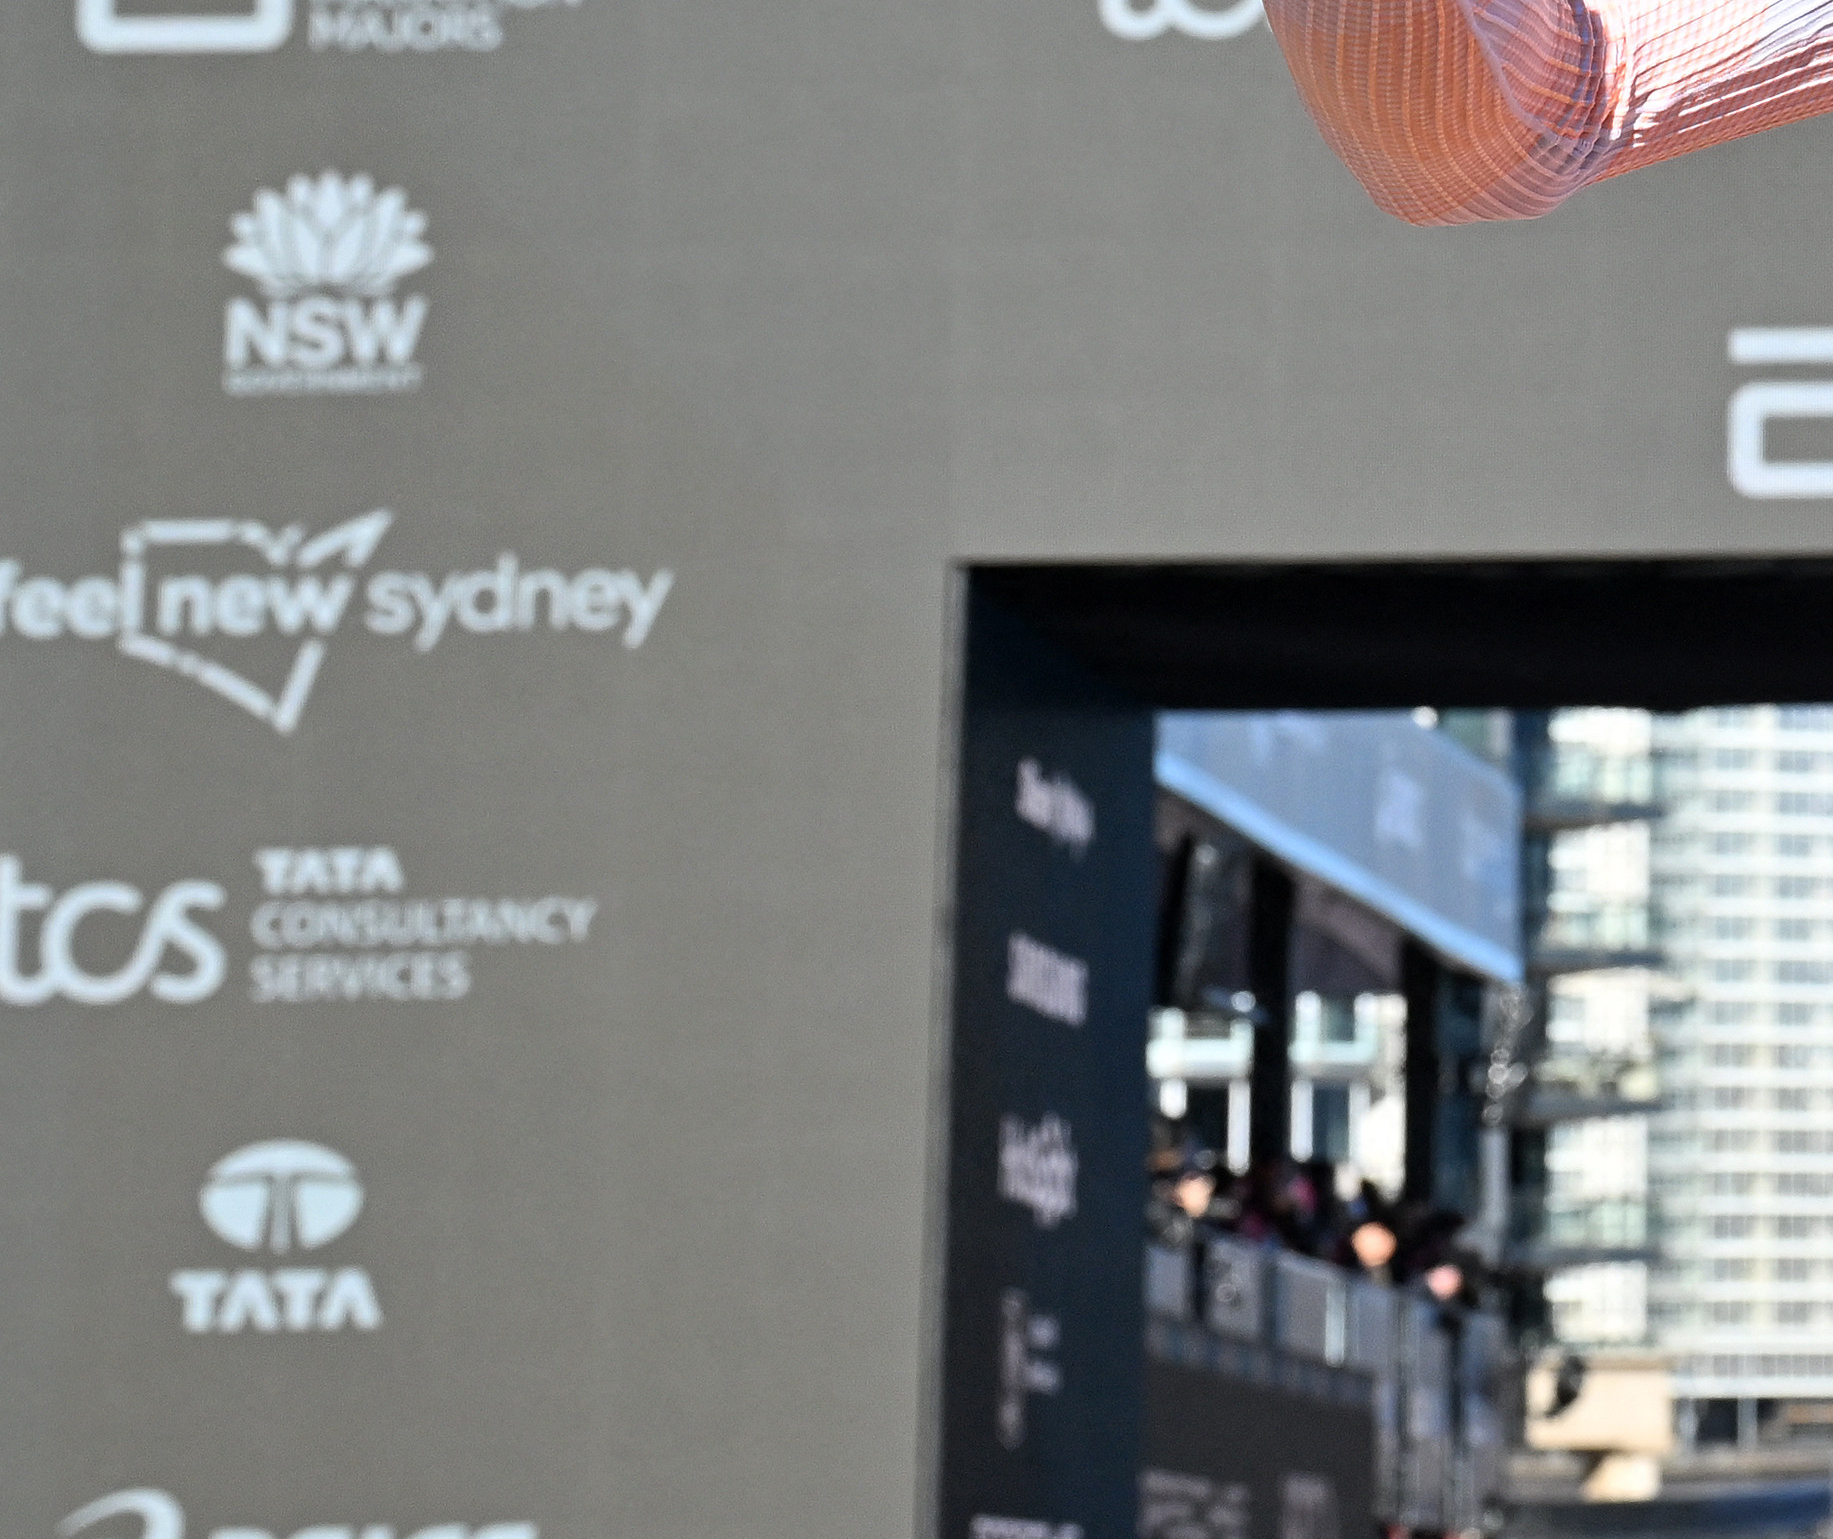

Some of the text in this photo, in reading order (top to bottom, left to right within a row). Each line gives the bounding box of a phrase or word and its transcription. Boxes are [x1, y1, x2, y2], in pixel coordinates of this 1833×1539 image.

[225, 297, 429, 369] NSW
[160, 574, 354, 635] new
[366, 551, 675, 652] sydney
[254, 846, 403, 894] TATA
[0, 854, 228, 1007] tcs
[250, 896, 599, 950] CONSULTANCY
[250, 951, 471, 1003] SERVICES
[170, 1268, 384, 1333] TATA
